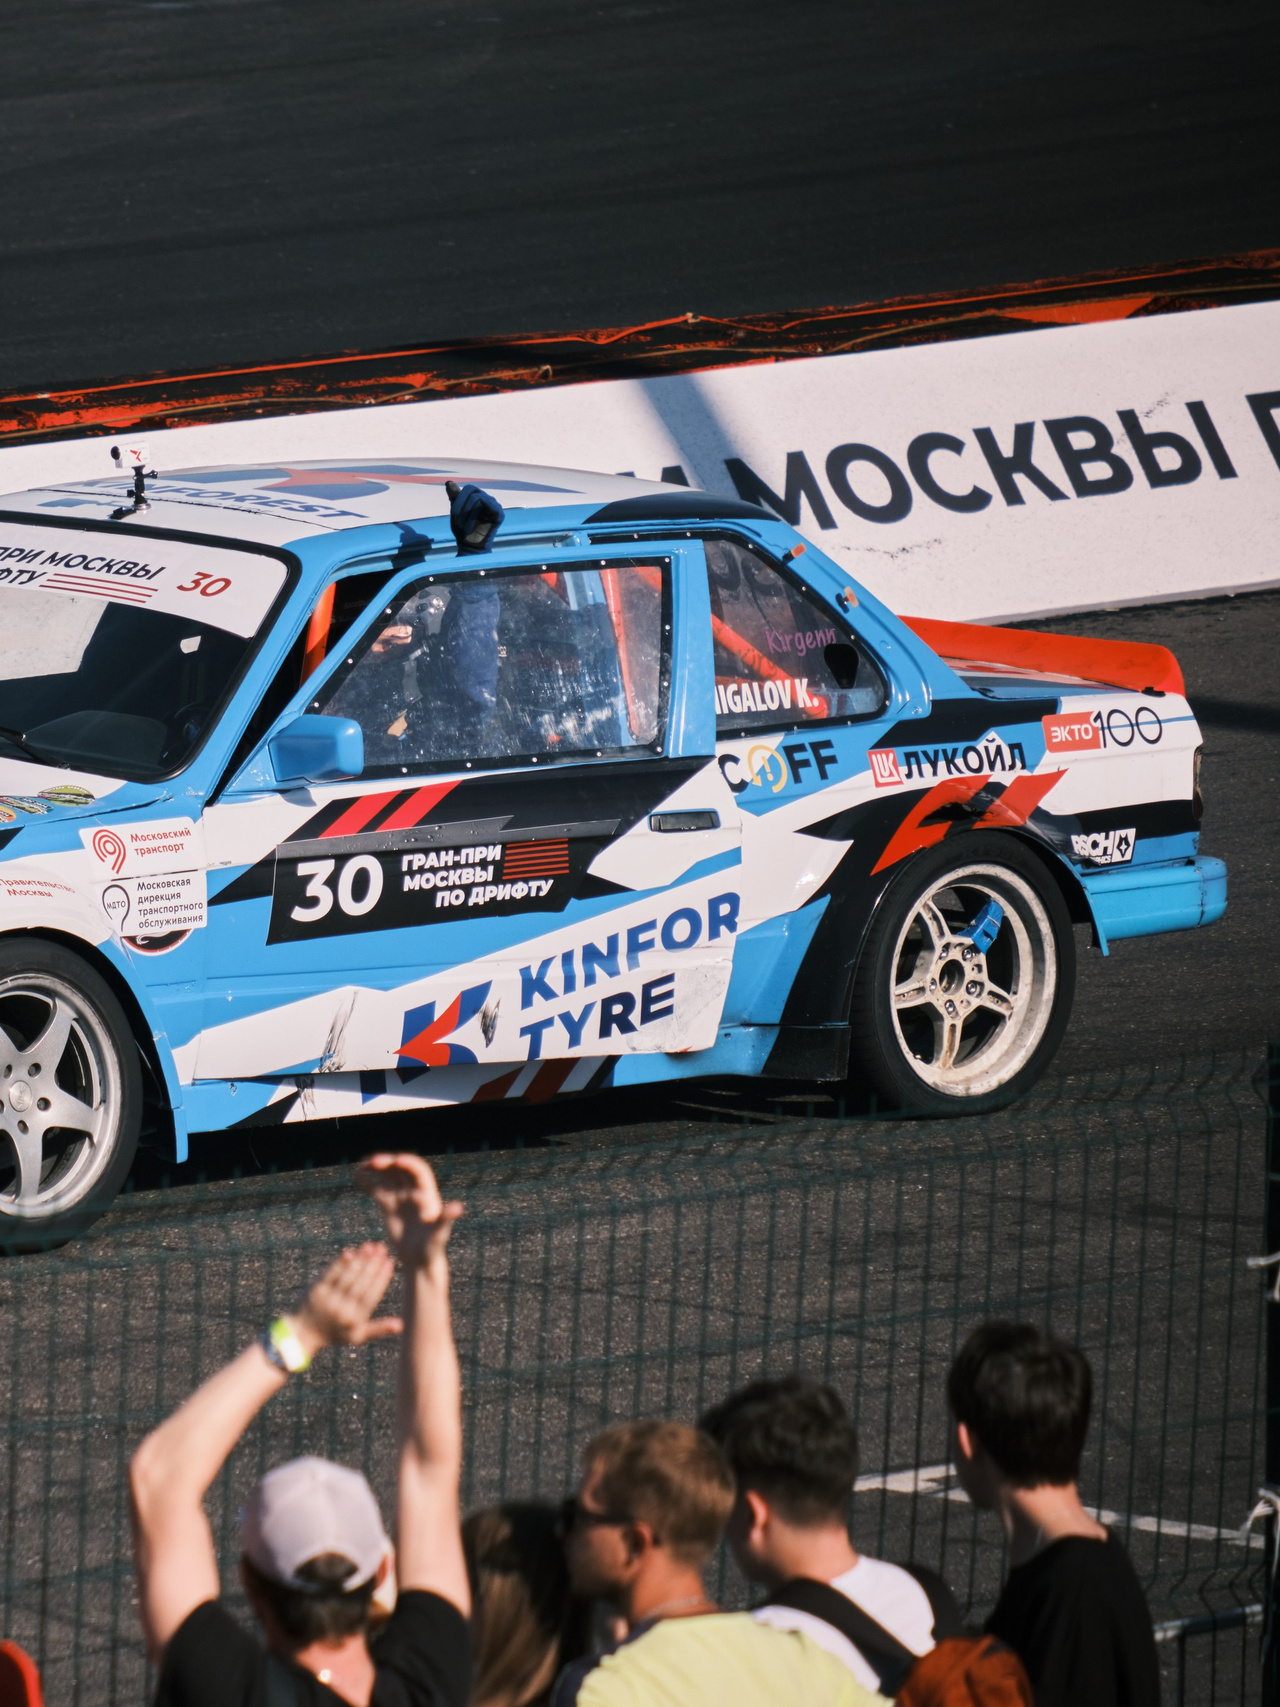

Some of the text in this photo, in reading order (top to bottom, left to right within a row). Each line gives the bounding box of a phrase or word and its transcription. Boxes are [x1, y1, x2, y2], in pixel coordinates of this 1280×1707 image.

[723, 399, 1238, 531] МОСКВЫ
[40, 551, 167, 580] МОСКВЫ
[177, 572, 233, 598] 30
[794, 677, 820, 708] K.
[1051, 706, 1163, 749] ЭКТО 100
[904, 737, 1027, 780] ЛУКОЙЛ
[130, 827, 192, 843] Московский
[134, 843, 185, 857] транспорт
[401, 844, 503, 871] ГРАН-ПРИ
[137, 878, 191, 891] Московская
[290, 854, 384, 922] 30
[403, 865, 494, 892] МОСКВЫ
[6, 888, 54, 898] Москвы
[137, 892, 181, 905] дирекция
[435, 879, 554, 908] ПО ДРИФТУ
[138, 902, 204, 917] транспортного
[139, 914, 203, 929] обслуживания
[519, 891, 741, 1010] KINFOR
[520, 973, 675, 1061] TYRE
